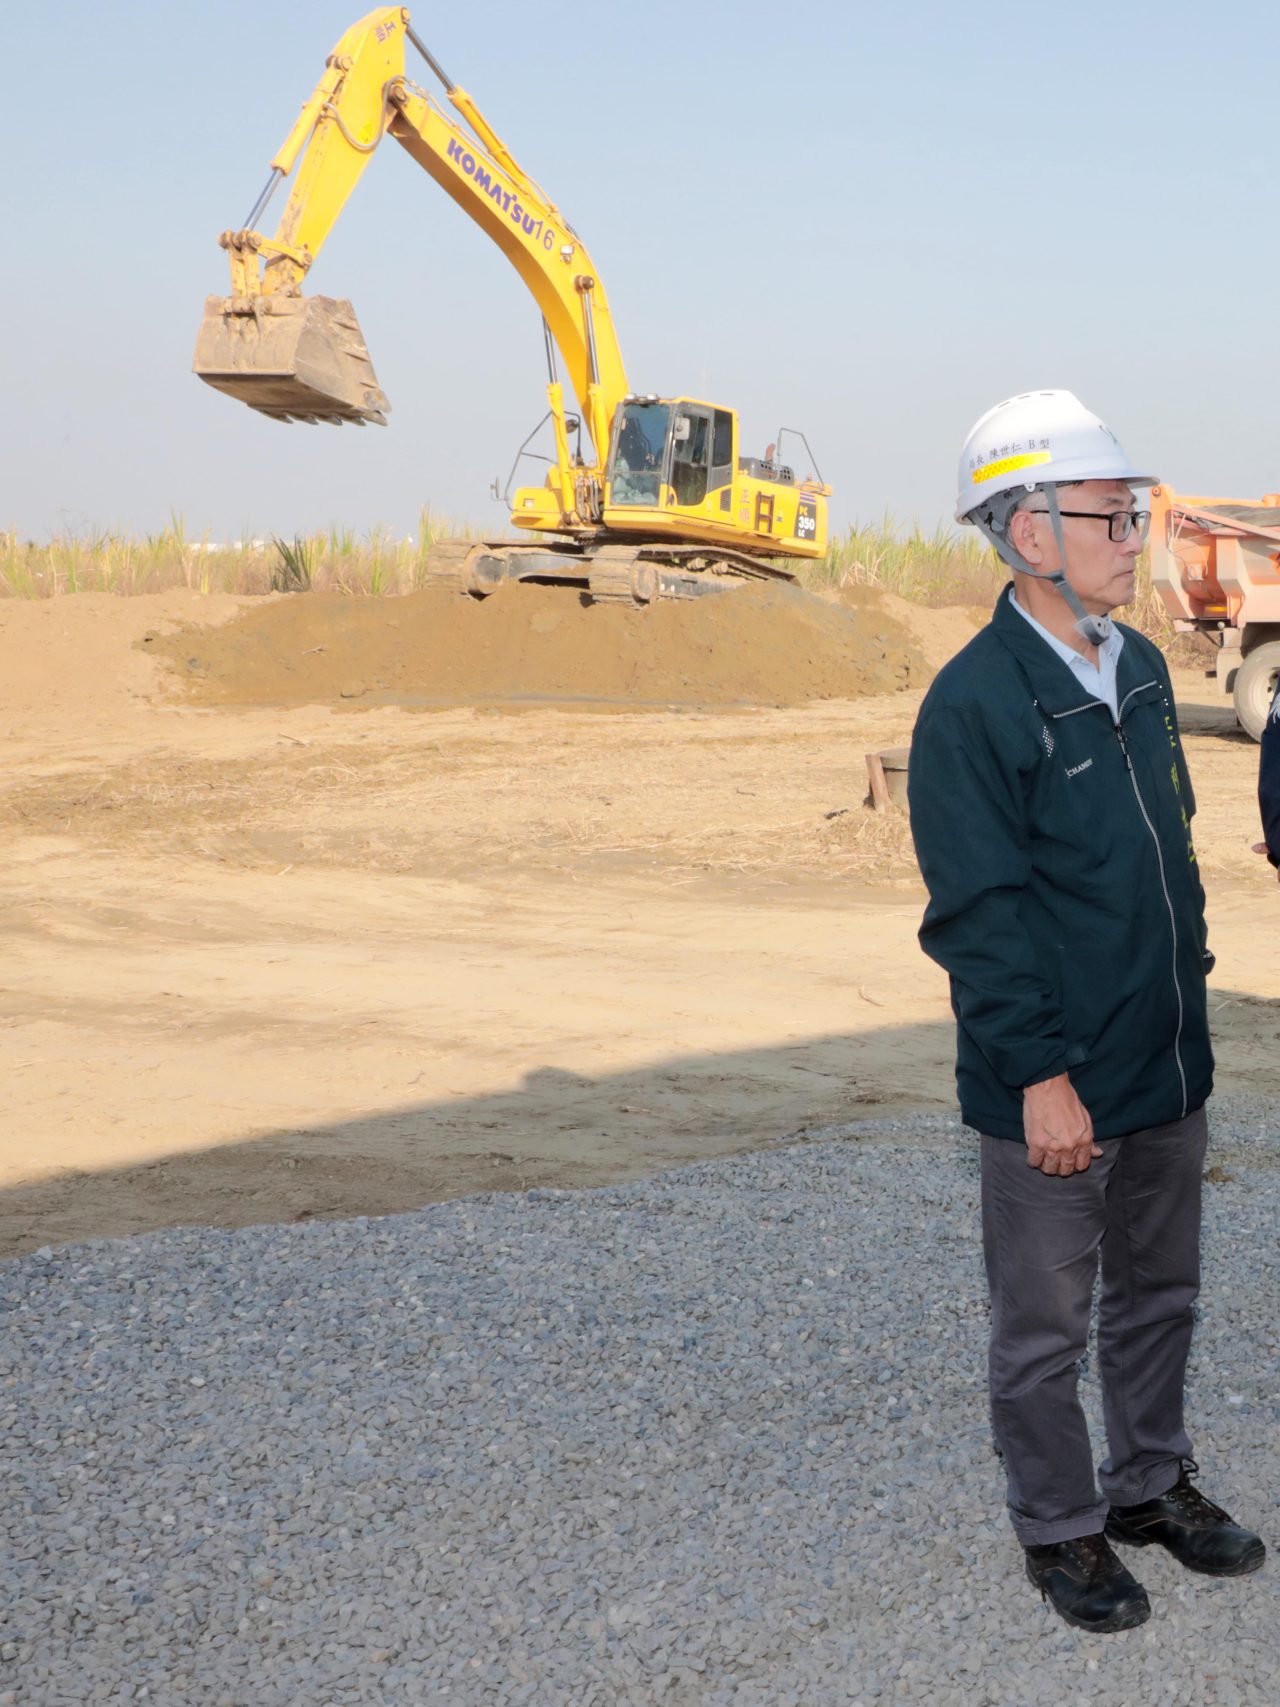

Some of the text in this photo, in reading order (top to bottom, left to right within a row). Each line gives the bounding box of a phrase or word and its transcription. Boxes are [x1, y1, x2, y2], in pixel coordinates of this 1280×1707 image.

[446, 137, 555, 251] KOMATSU 16
[798, 516, 815, 531] 350
